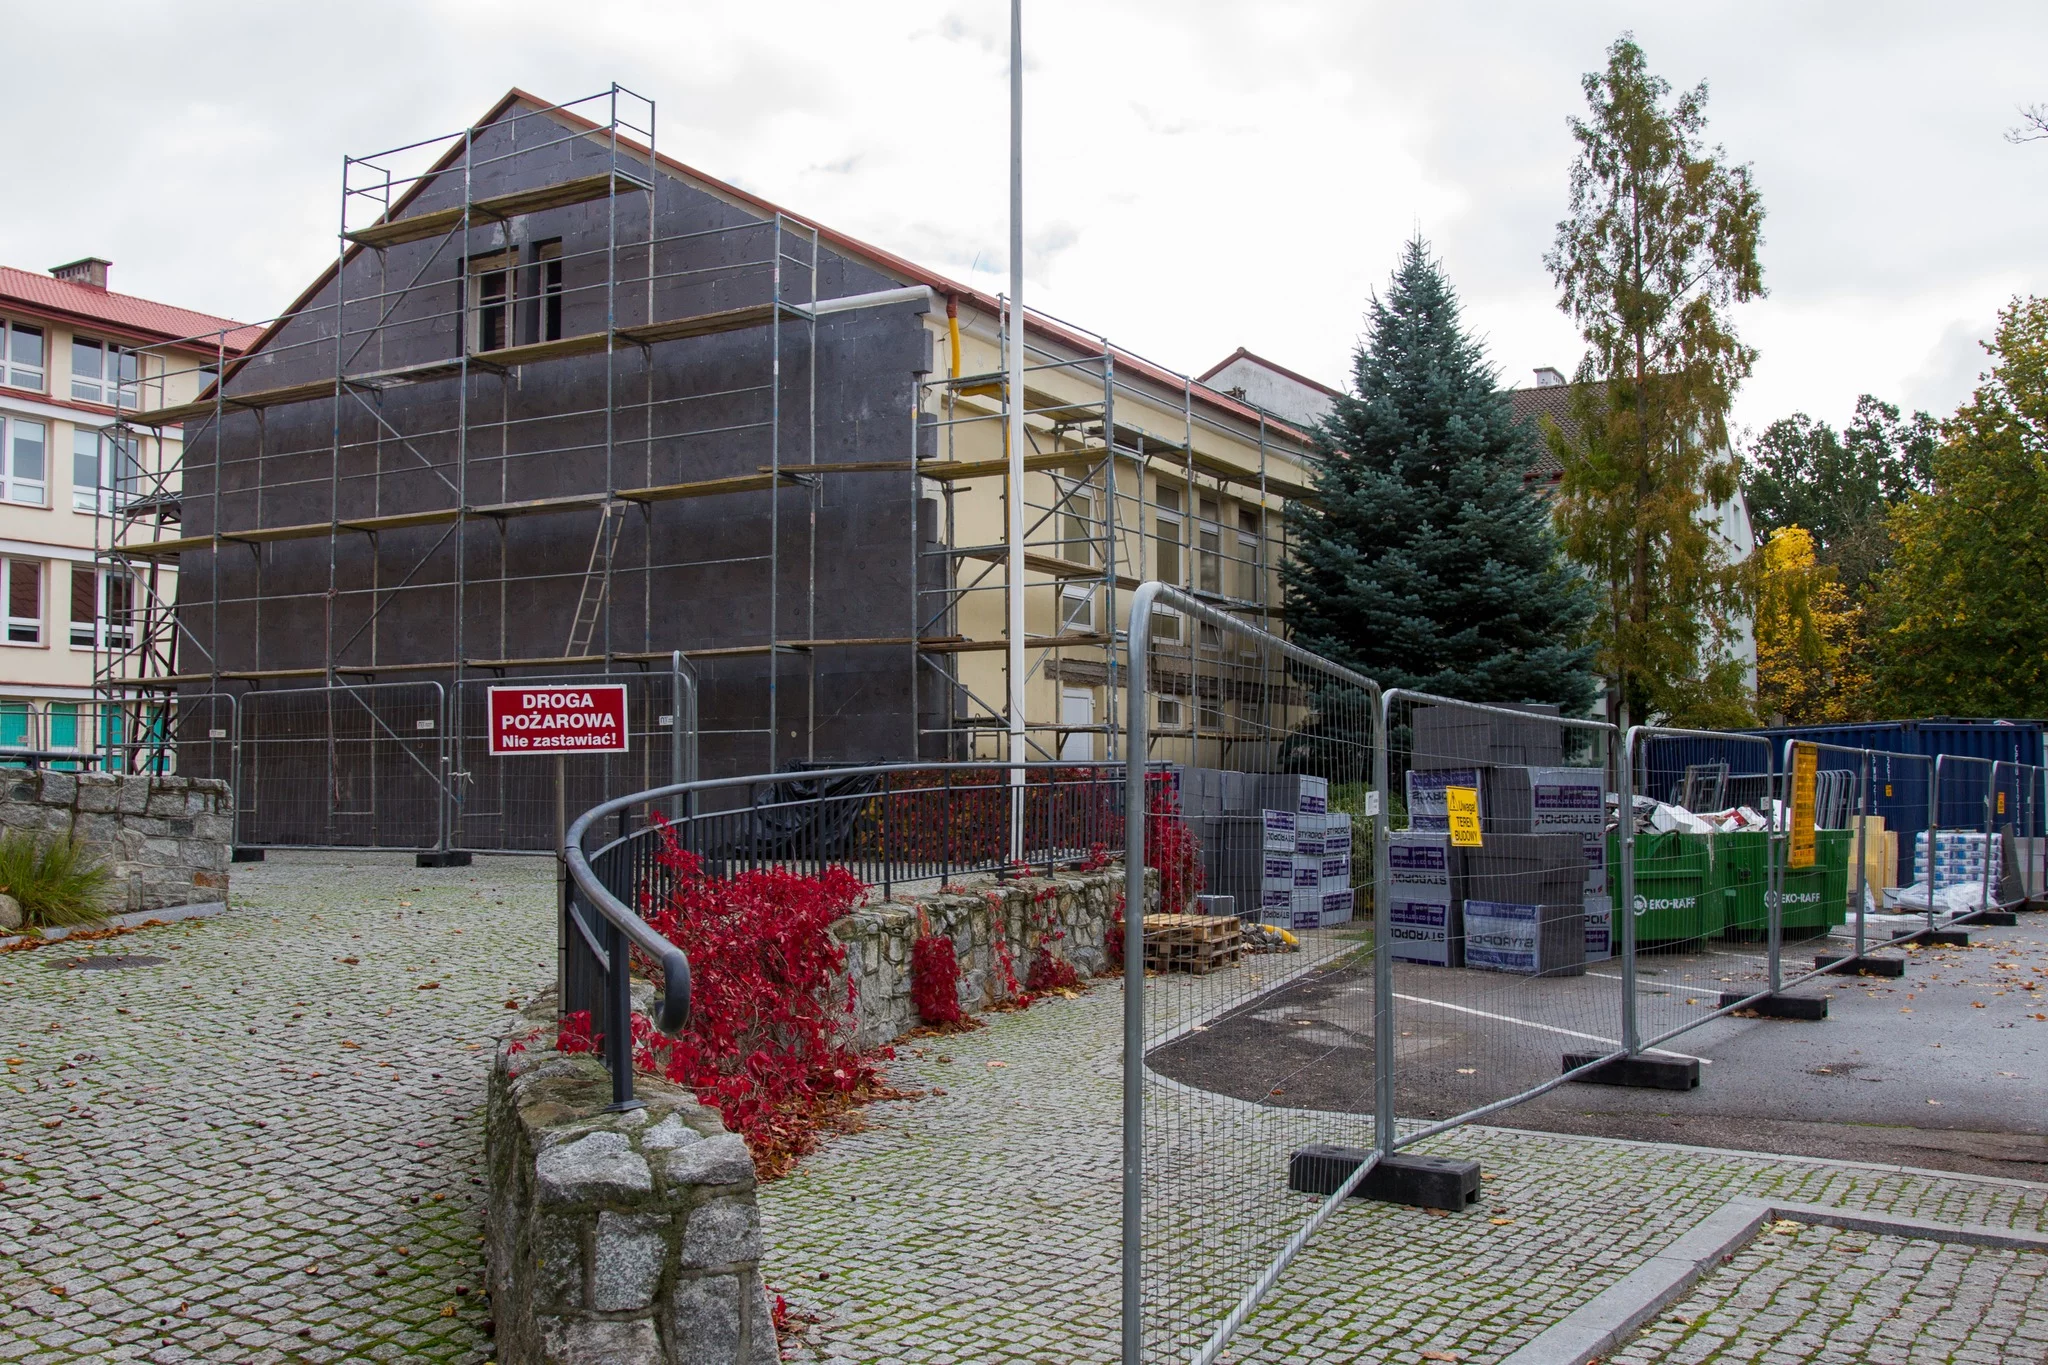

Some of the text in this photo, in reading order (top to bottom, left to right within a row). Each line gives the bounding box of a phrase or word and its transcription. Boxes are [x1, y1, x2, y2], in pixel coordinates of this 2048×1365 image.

[523, 693, 594, 709] DROGA
[502, 711, 616, 730] POŻAROWA
[502, 733, 617, 748] Nie zastawiać!
[1456, 816, 1474, 828] TEREN
[1538, 814, 1601, 825] STYROPOL
[1267, 832, 1294, 843] STYROPOL
[1298, 830, 1325, 840] STYROPOL
[1455, 830, 1478, 842] BUDOWY
[1393, 873, 1446, 885] STYROPOL
[1649, 897, 1696, 910] EKO-RAFF
[1781, 892, 1820, 904] EKO-RAFF
